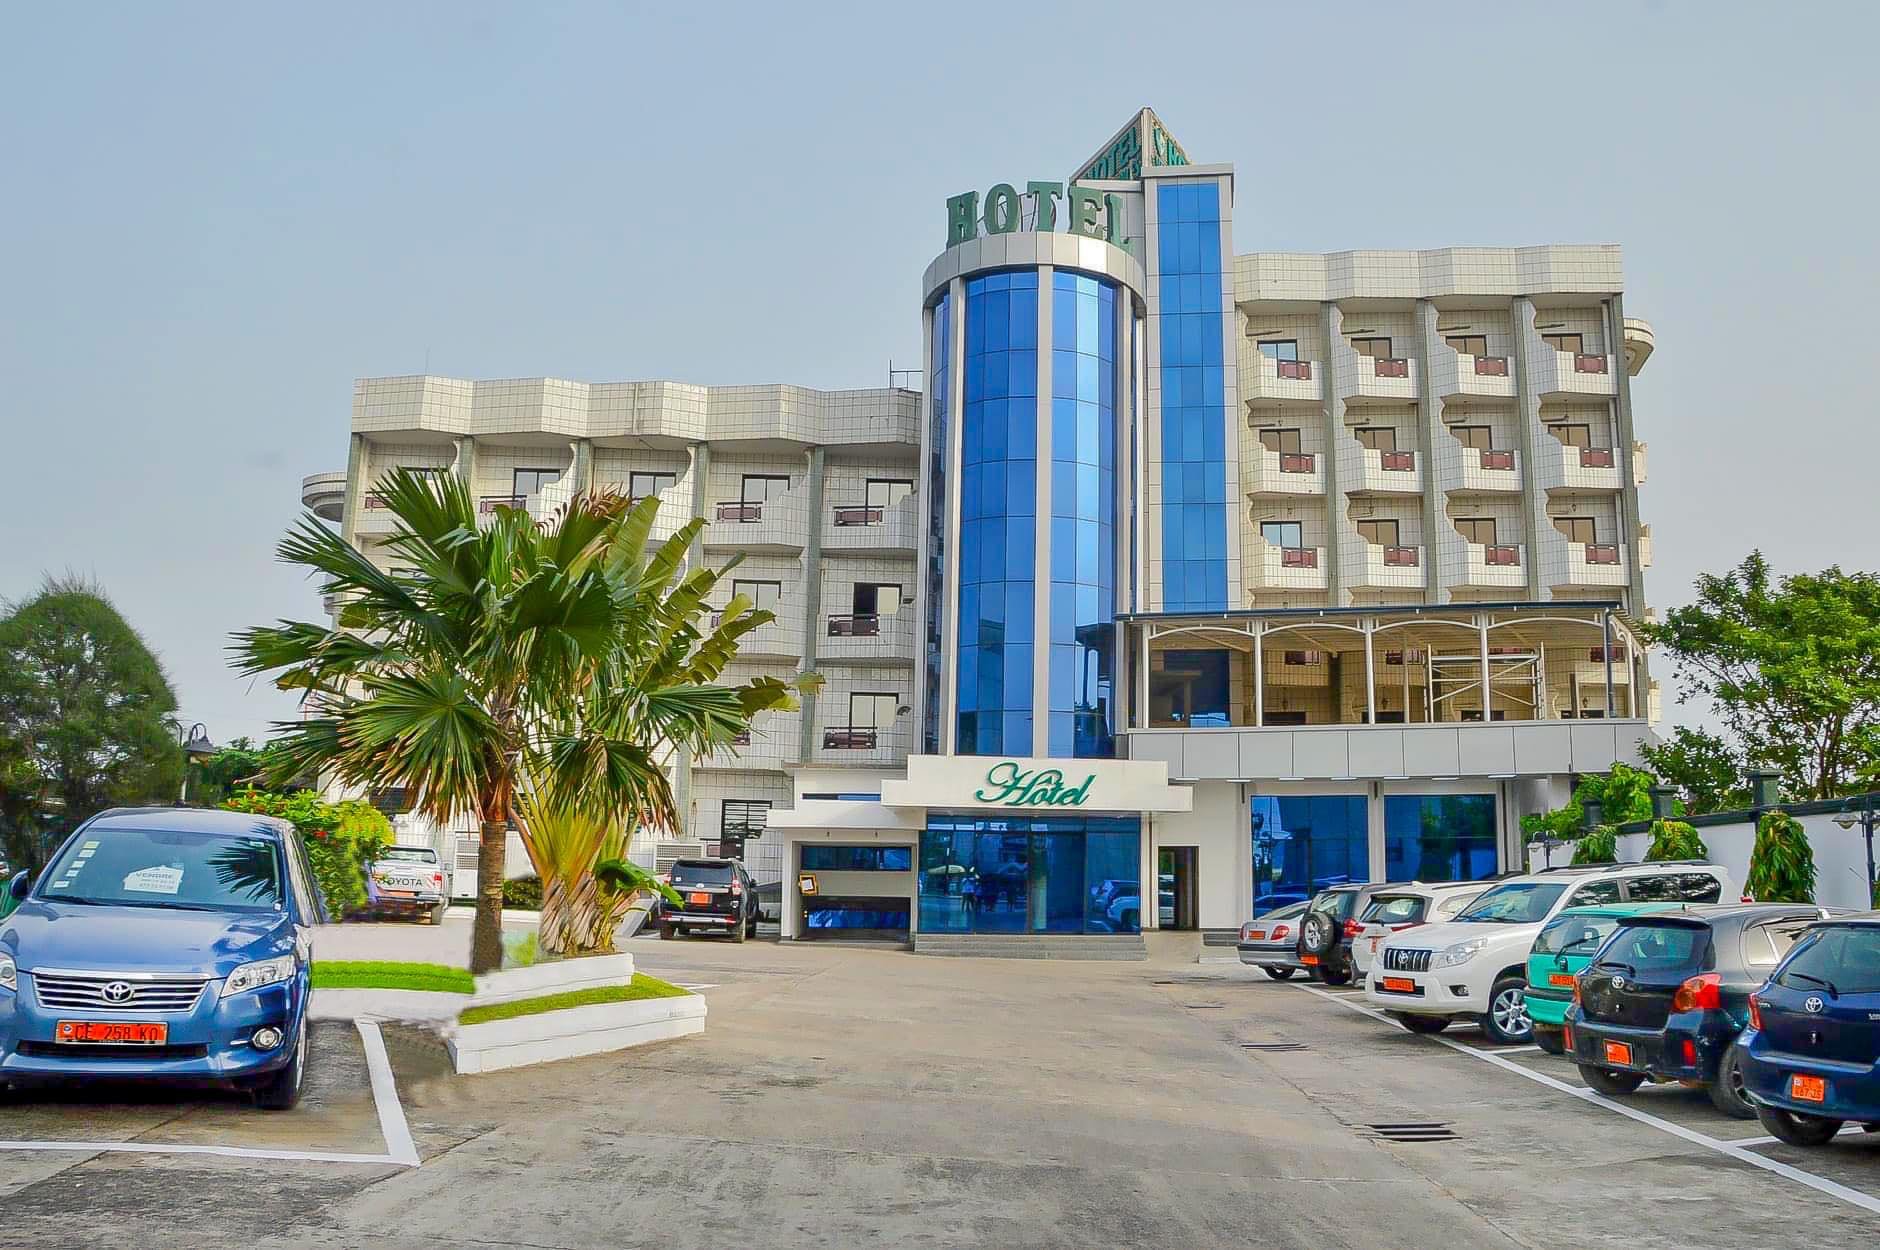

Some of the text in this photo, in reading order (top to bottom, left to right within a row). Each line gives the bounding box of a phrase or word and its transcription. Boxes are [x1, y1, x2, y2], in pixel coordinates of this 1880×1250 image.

[946, 181, 1134, 253] HOTEL
[385, 877, 422, 887] OYOTA
[75, 1022, 93, 1040] CE
[104, 1025, 131, 1040] 258
